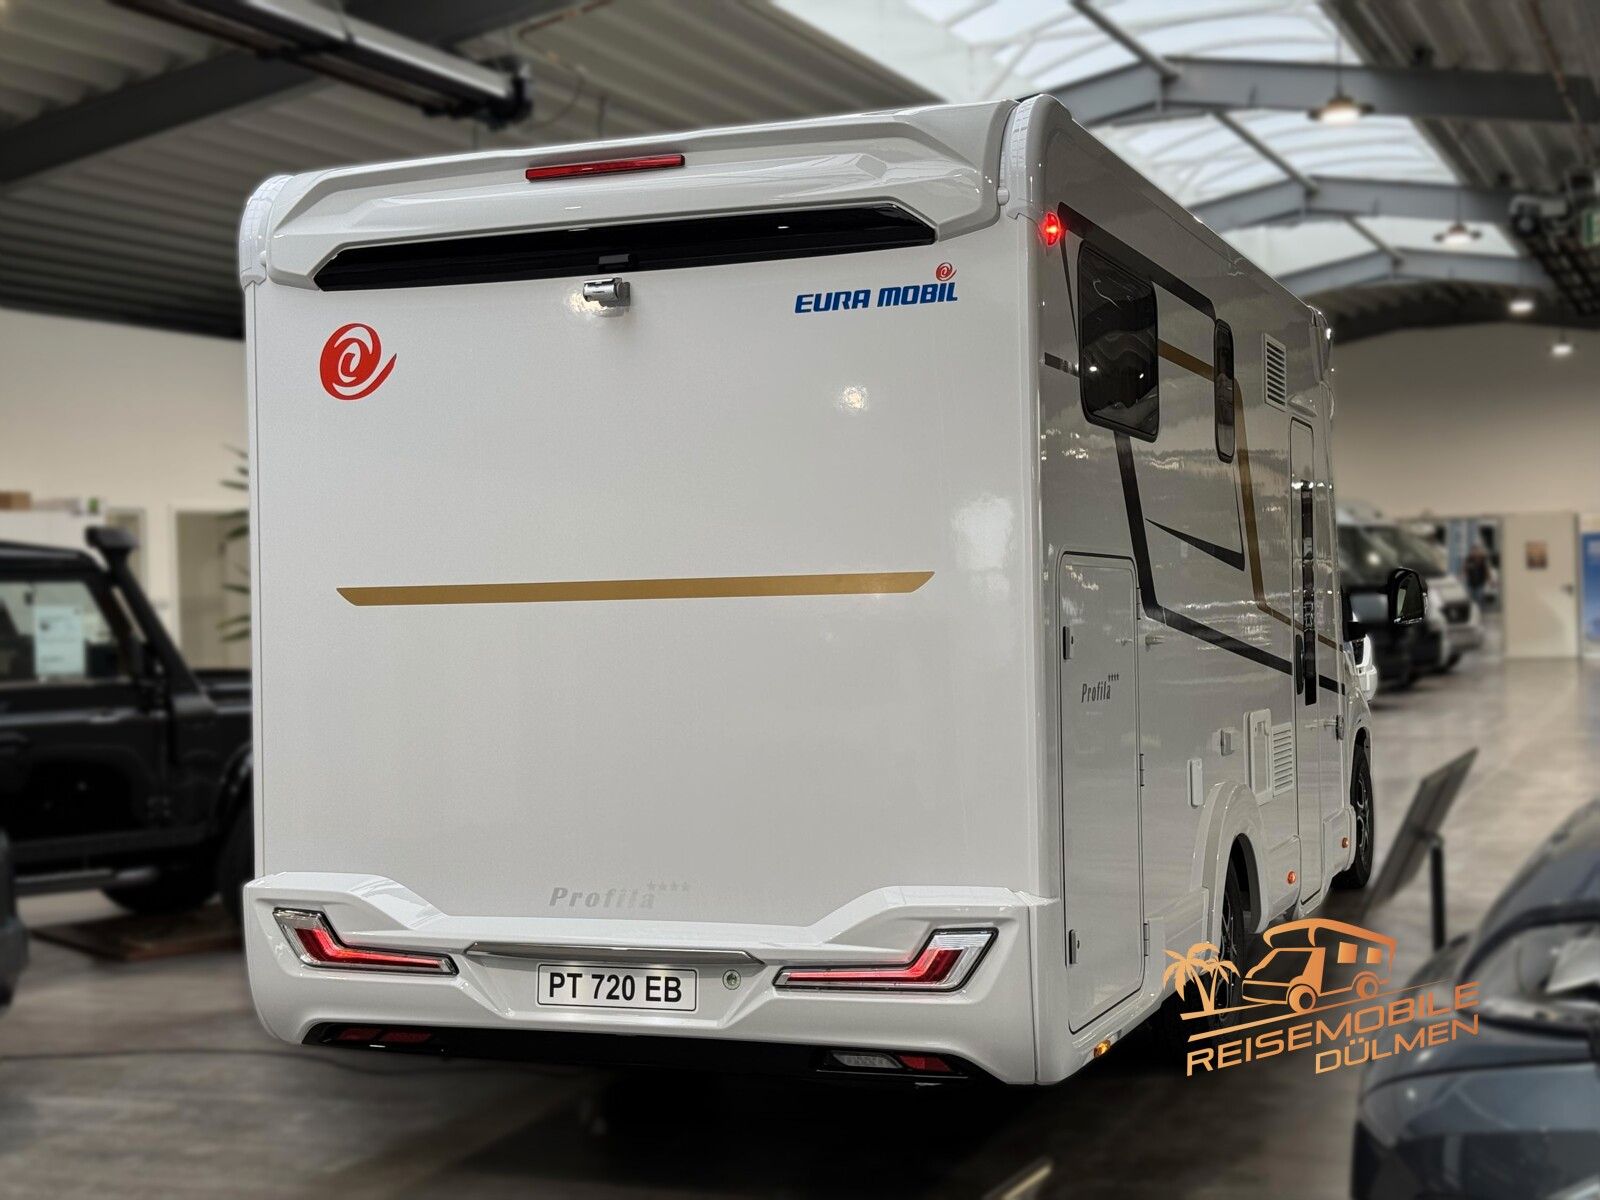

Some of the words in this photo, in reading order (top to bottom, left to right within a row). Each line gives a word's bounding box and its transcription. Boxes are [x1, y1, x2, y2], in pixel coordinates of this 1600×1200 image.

[795, 289, 871, 313] EURA
[877, 282, 958, 307] MOBIL
[1081, 681, 1111, 703] Profila
[549, 887, 655, 909] Profila
[549, 972, 583, 998] PT
[591, 974, 635, 1001] 720
[645, 975, 682, 1003] EB
